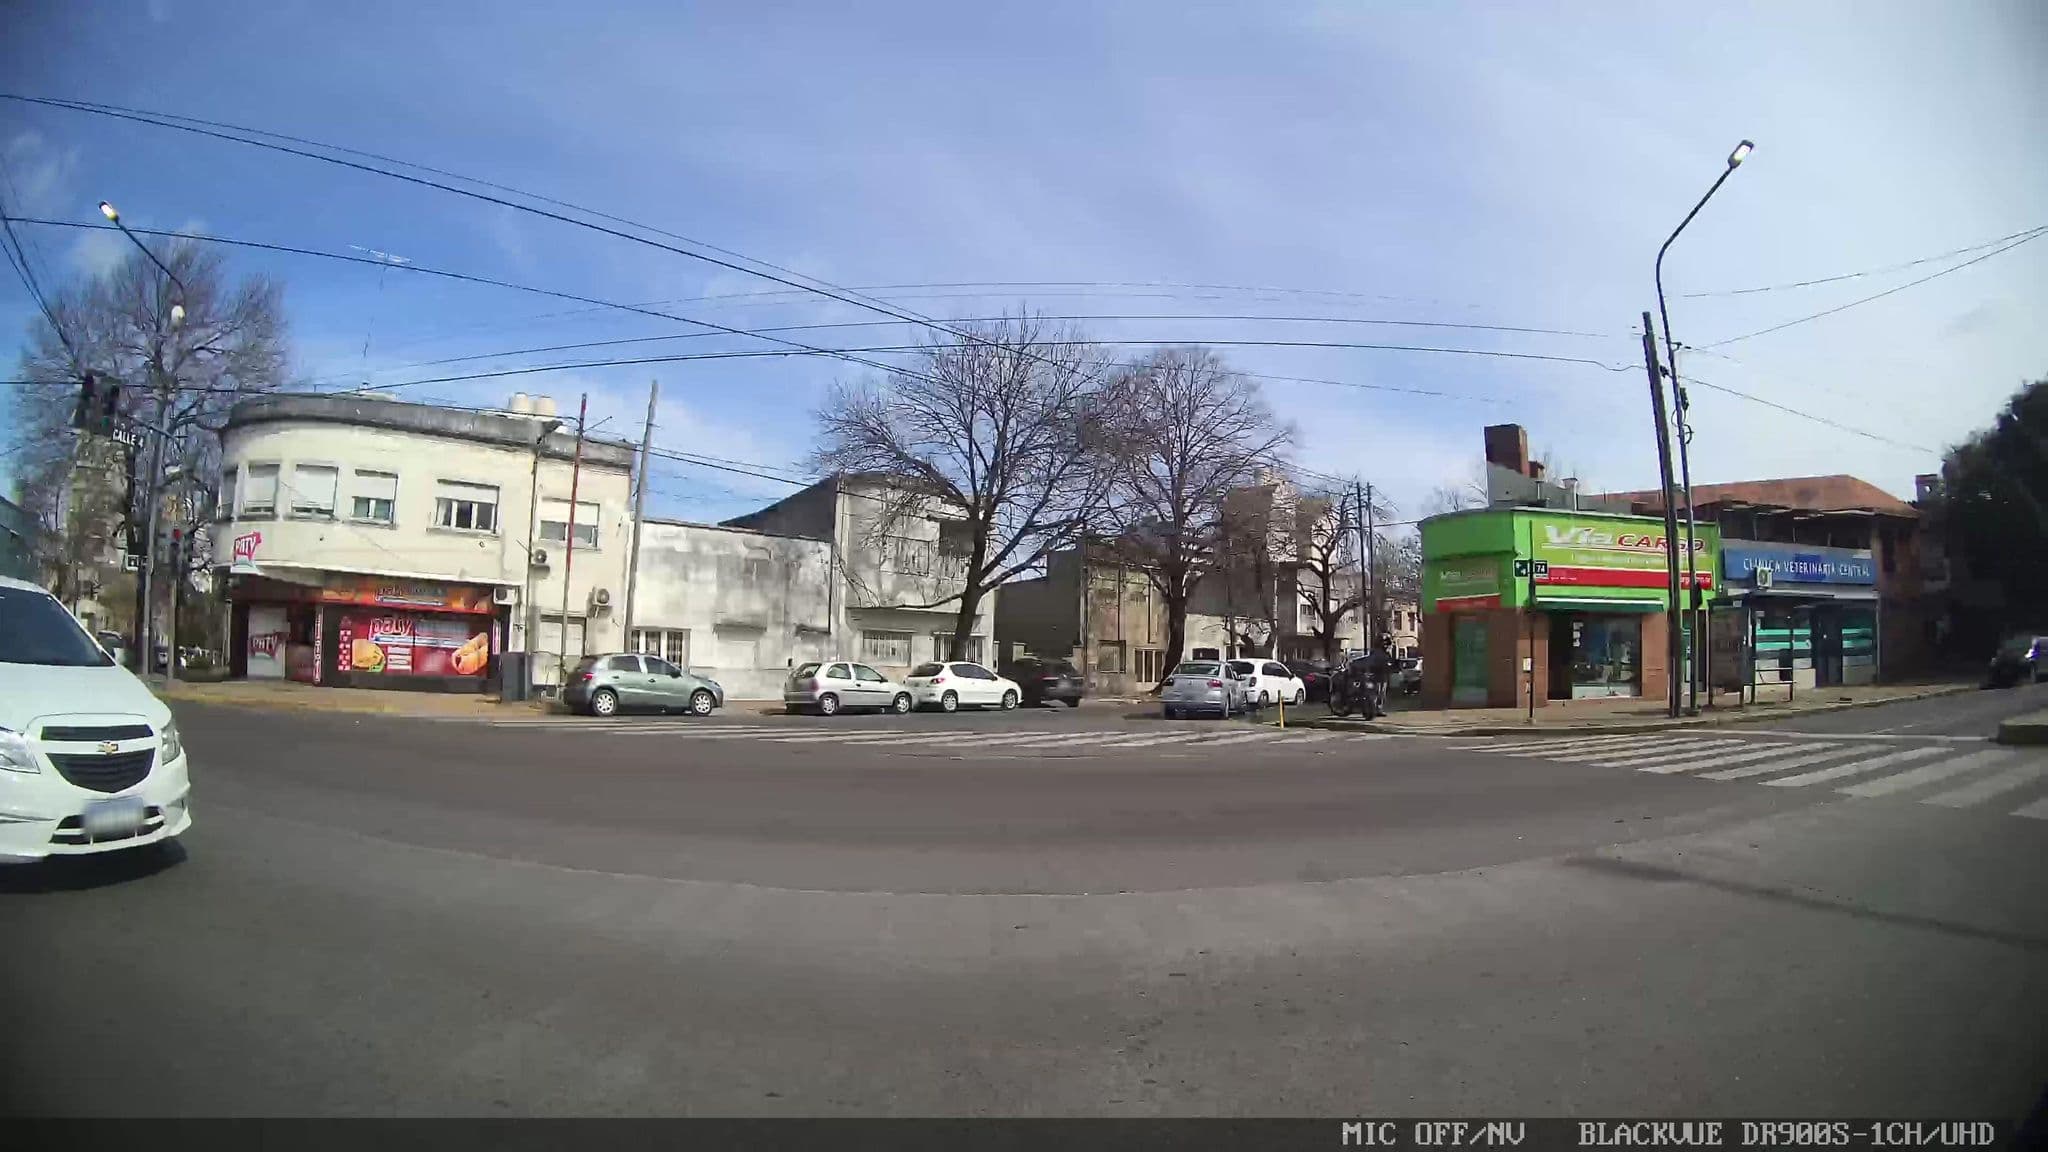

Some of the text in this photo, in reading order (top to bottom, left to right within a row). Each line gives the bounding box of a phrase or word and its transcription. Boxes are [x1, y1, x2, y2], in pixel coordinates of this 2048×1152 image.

[113, 430, 136, 446] CALLE
[235, 535, 257, 554] PATY
[1546, 526, 1613, 546] Via
[1783, 560, 1835, 577] VETERINARIA
[1839, 563, 1870, 577] CENTRAL
[252, 634, 278, 652] PATY
